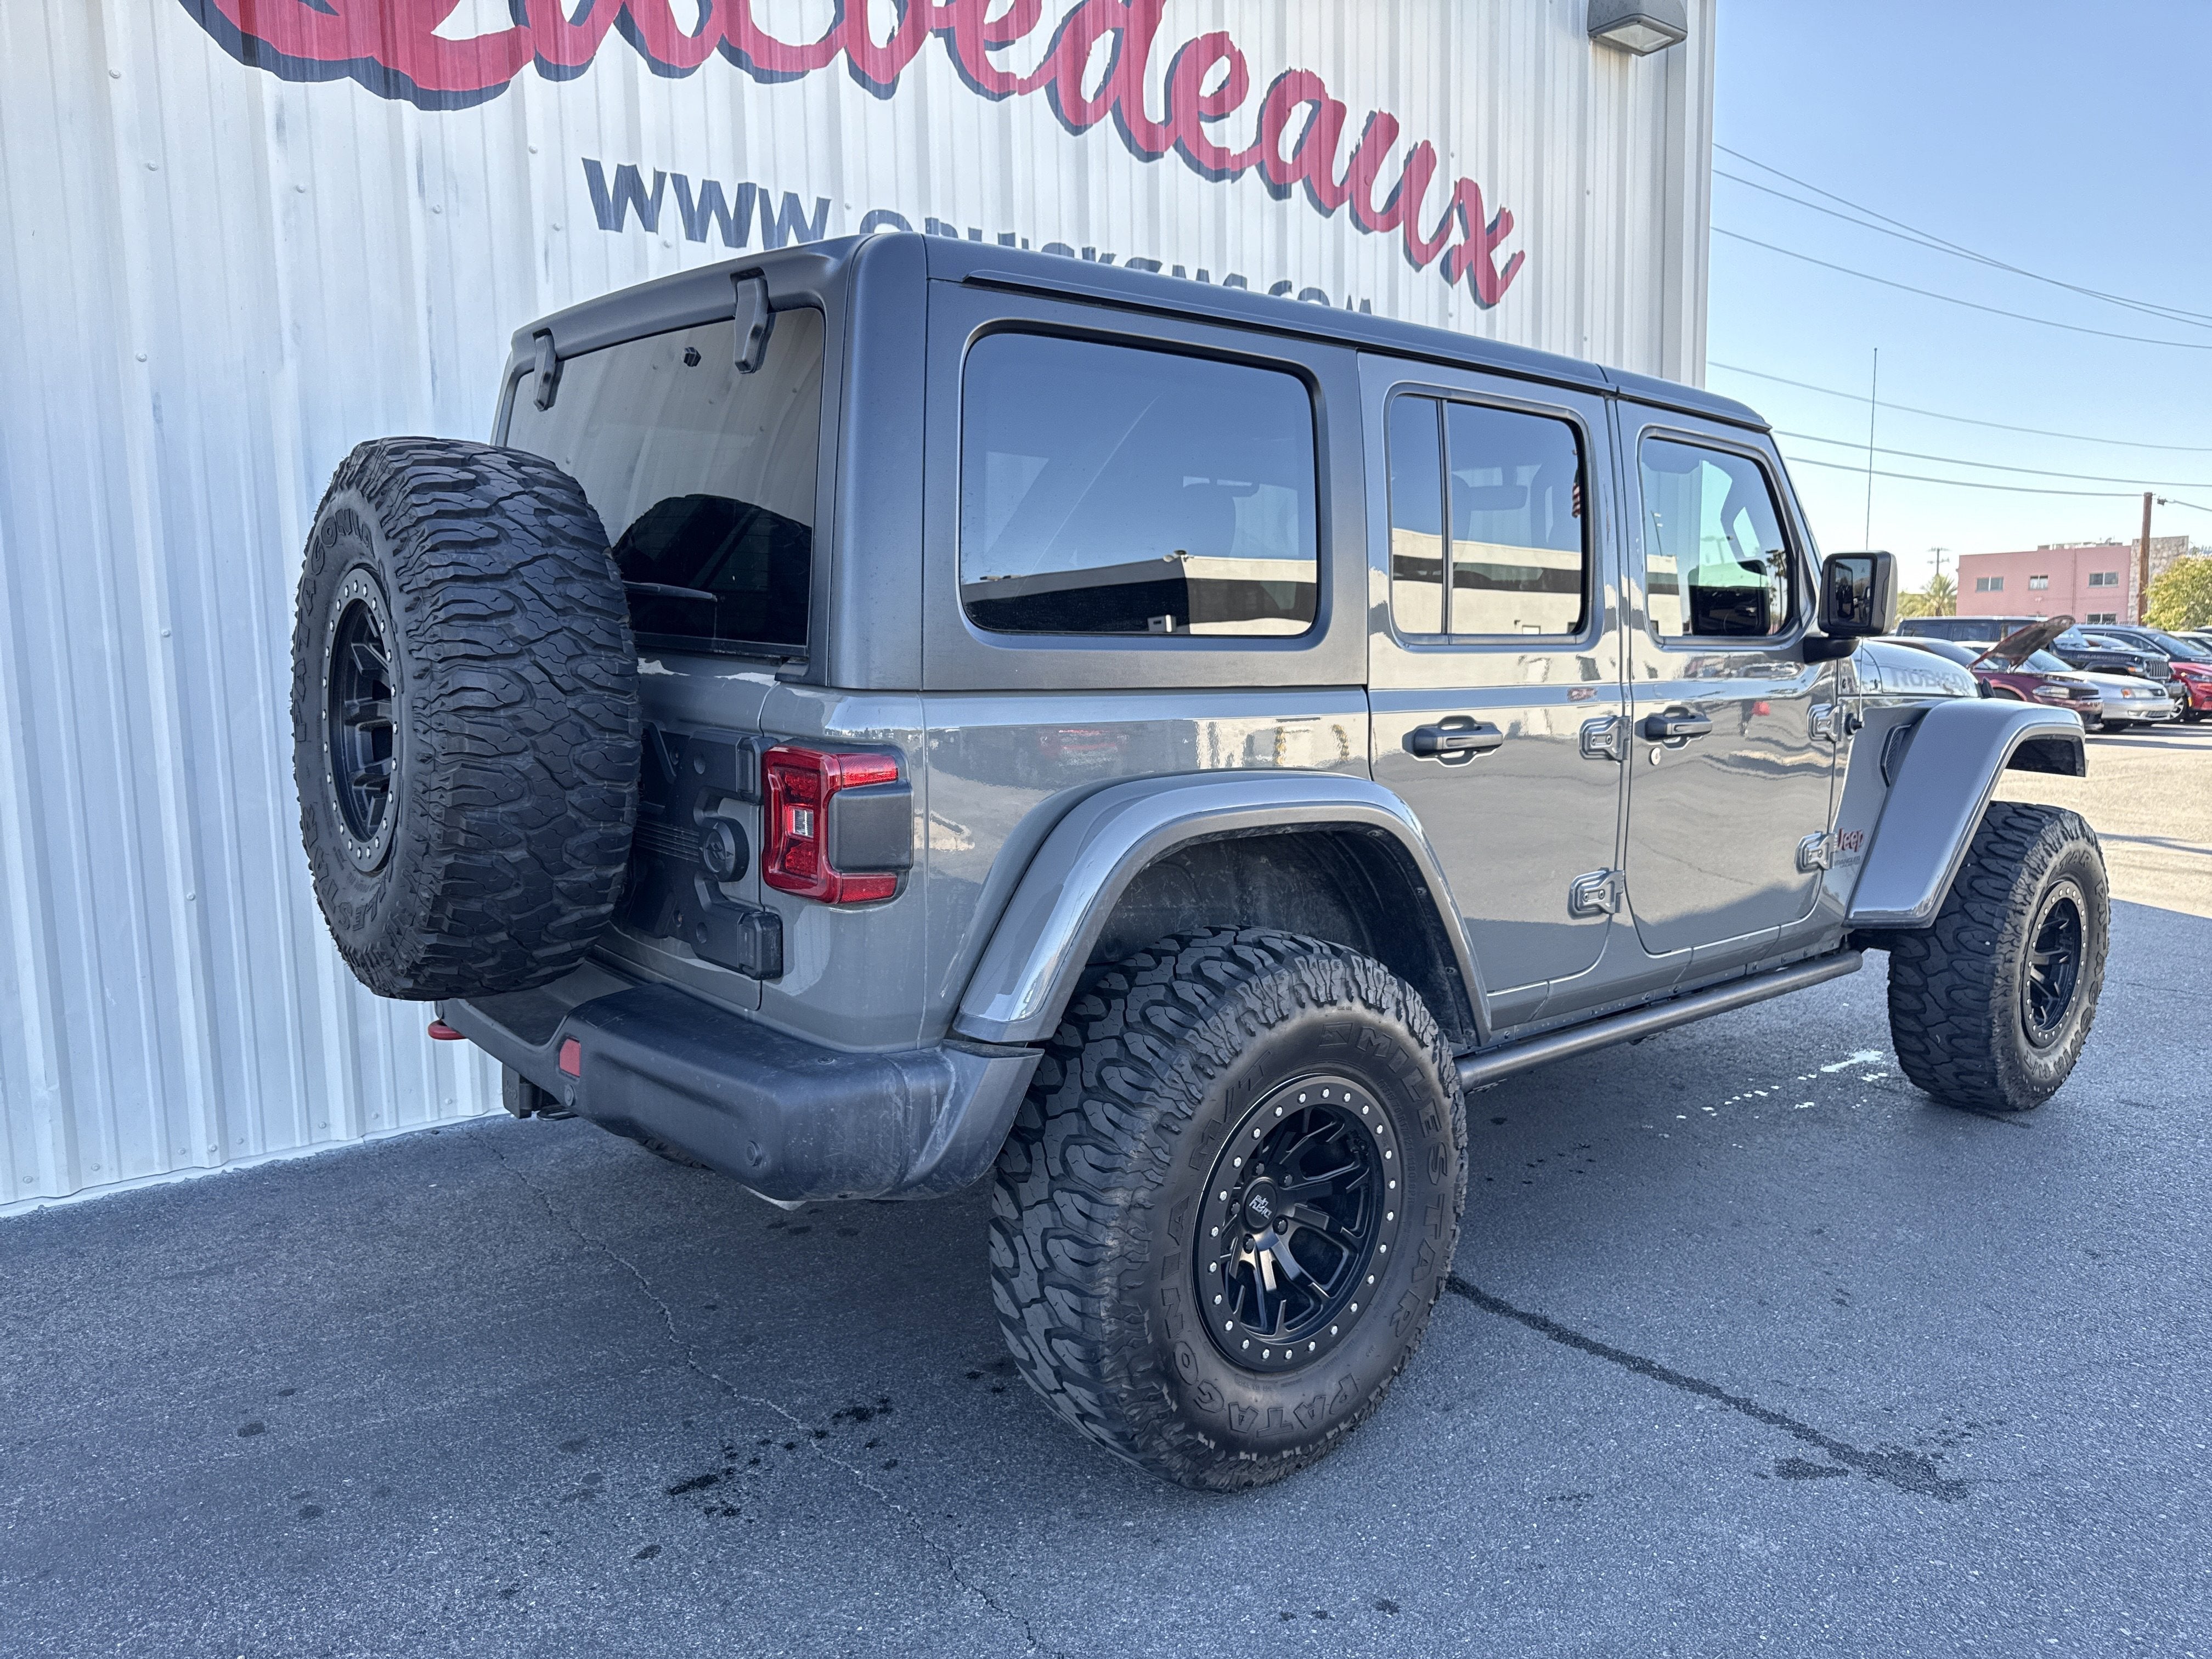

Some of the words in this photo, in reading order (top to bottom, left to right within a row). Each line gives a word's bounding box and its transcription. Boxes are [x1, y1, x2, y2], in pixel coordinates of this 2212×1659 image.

[1837, 827, 1864, 853] Jeep
[1356, 1026, 1448, 1338] MILESTAR
[1160, 1194, 1359, 1438] PATAGONIA
